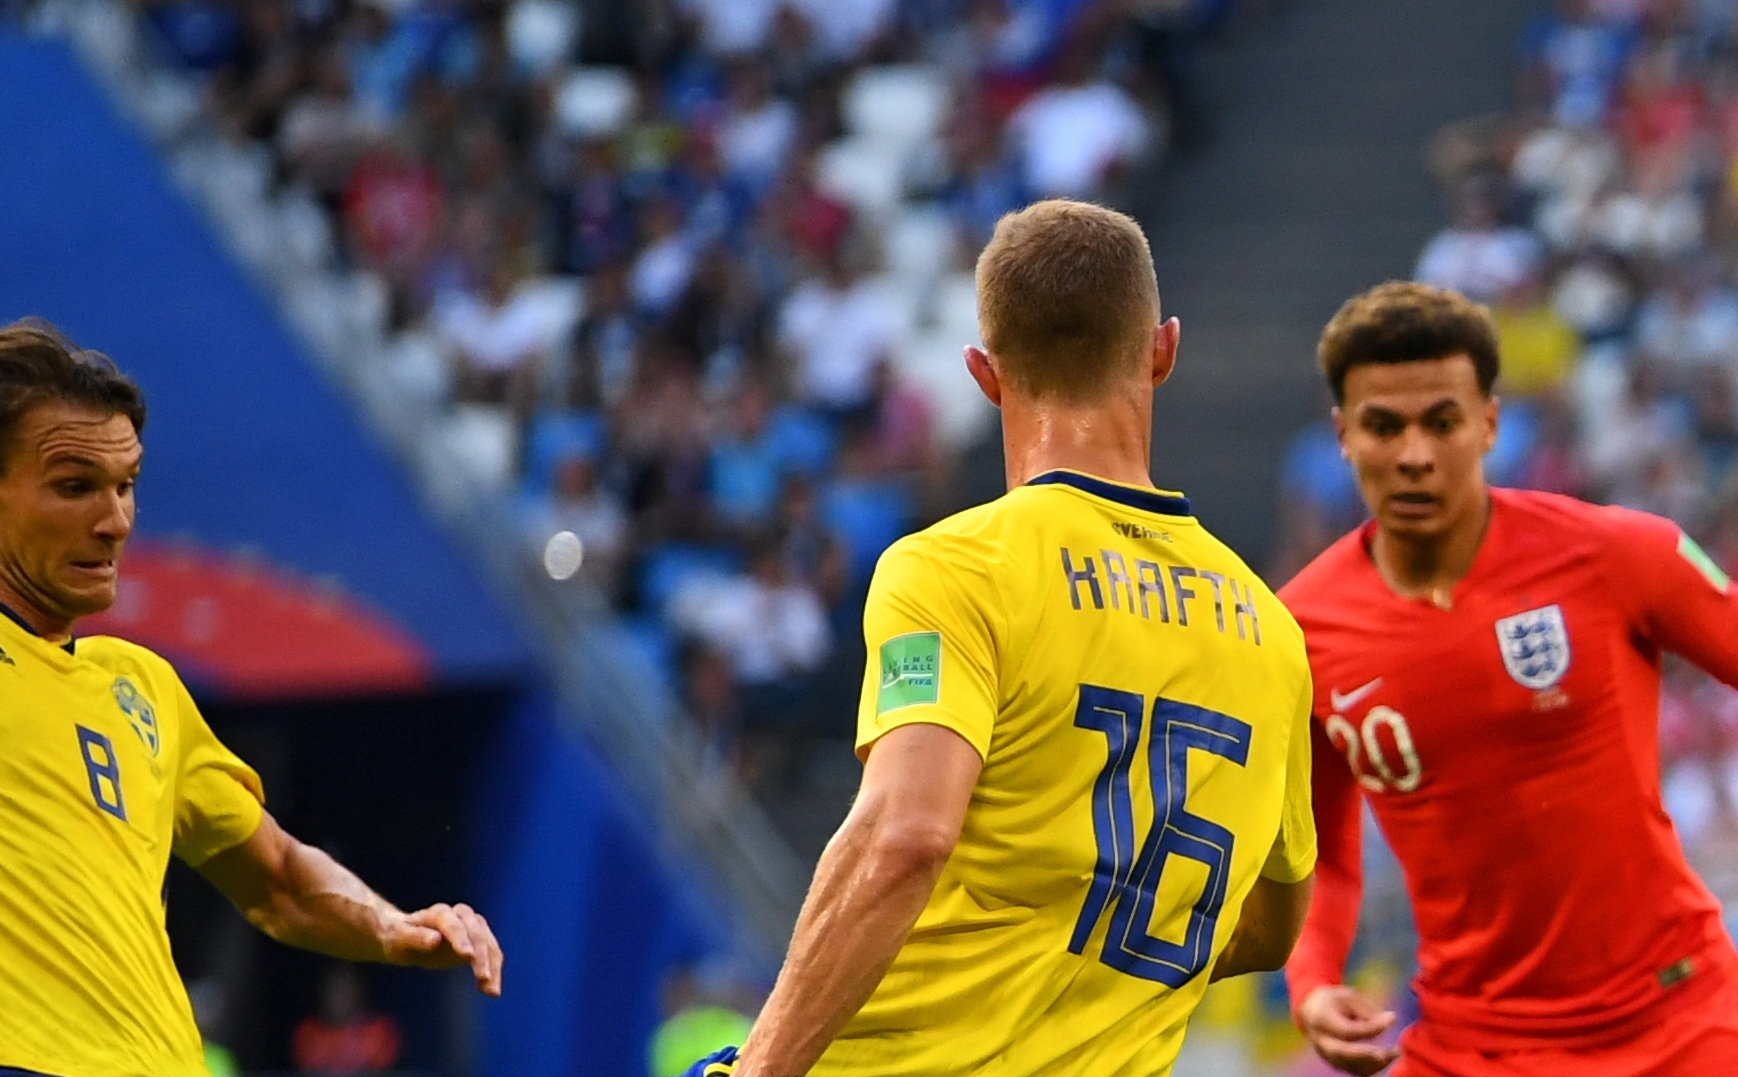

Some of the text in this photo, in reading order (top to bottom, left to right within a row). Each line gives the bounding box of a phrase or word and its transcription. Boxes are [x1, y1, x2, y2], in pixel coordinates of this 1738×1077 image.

[1060, 547, 1261, 646] KRAFTH
[75, 722, 128, 823] 8
[1325, 704, 1421, 794] 20
[1067, 683, 1252, 989] 16
